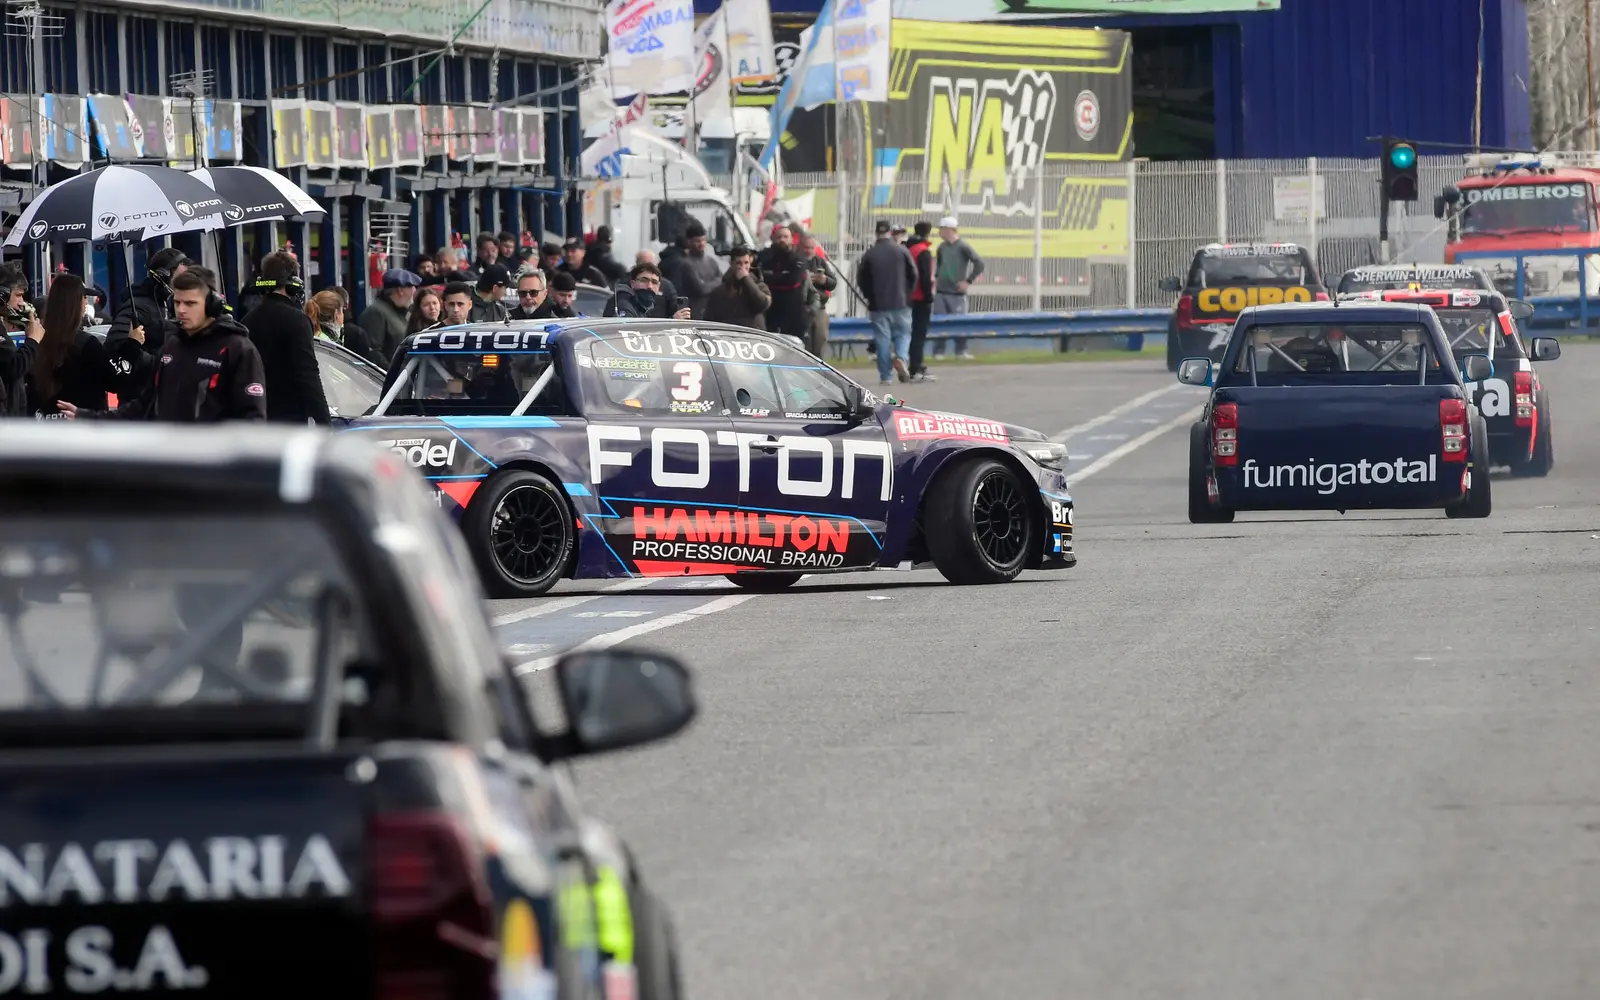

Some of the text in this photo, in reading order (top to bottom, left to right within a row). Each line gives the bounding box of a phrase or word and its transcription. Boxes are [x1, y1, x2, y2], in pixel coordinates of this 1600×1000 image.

[123, 210, 168, 222] FOTON
[192, 198, 223, 210] FOTON
[246, 202, 285, 214] FOTON
[411, 331, 550, 350] FOTON
[617, 330, 776, 362] EL RODEO
[671, 361, 703, 401] 3
[899, 417, 1005, 441] ALEJANDRO
[586, 424, 893, 501] FOTON
[1243, 454, 1437, 494] fumigatotal
[633, 507, 849, 553] HAMILTON
[632, 541, 845, 568] PROFESSIONAL BRAND
[64, 924, 209, 994] S.A.
